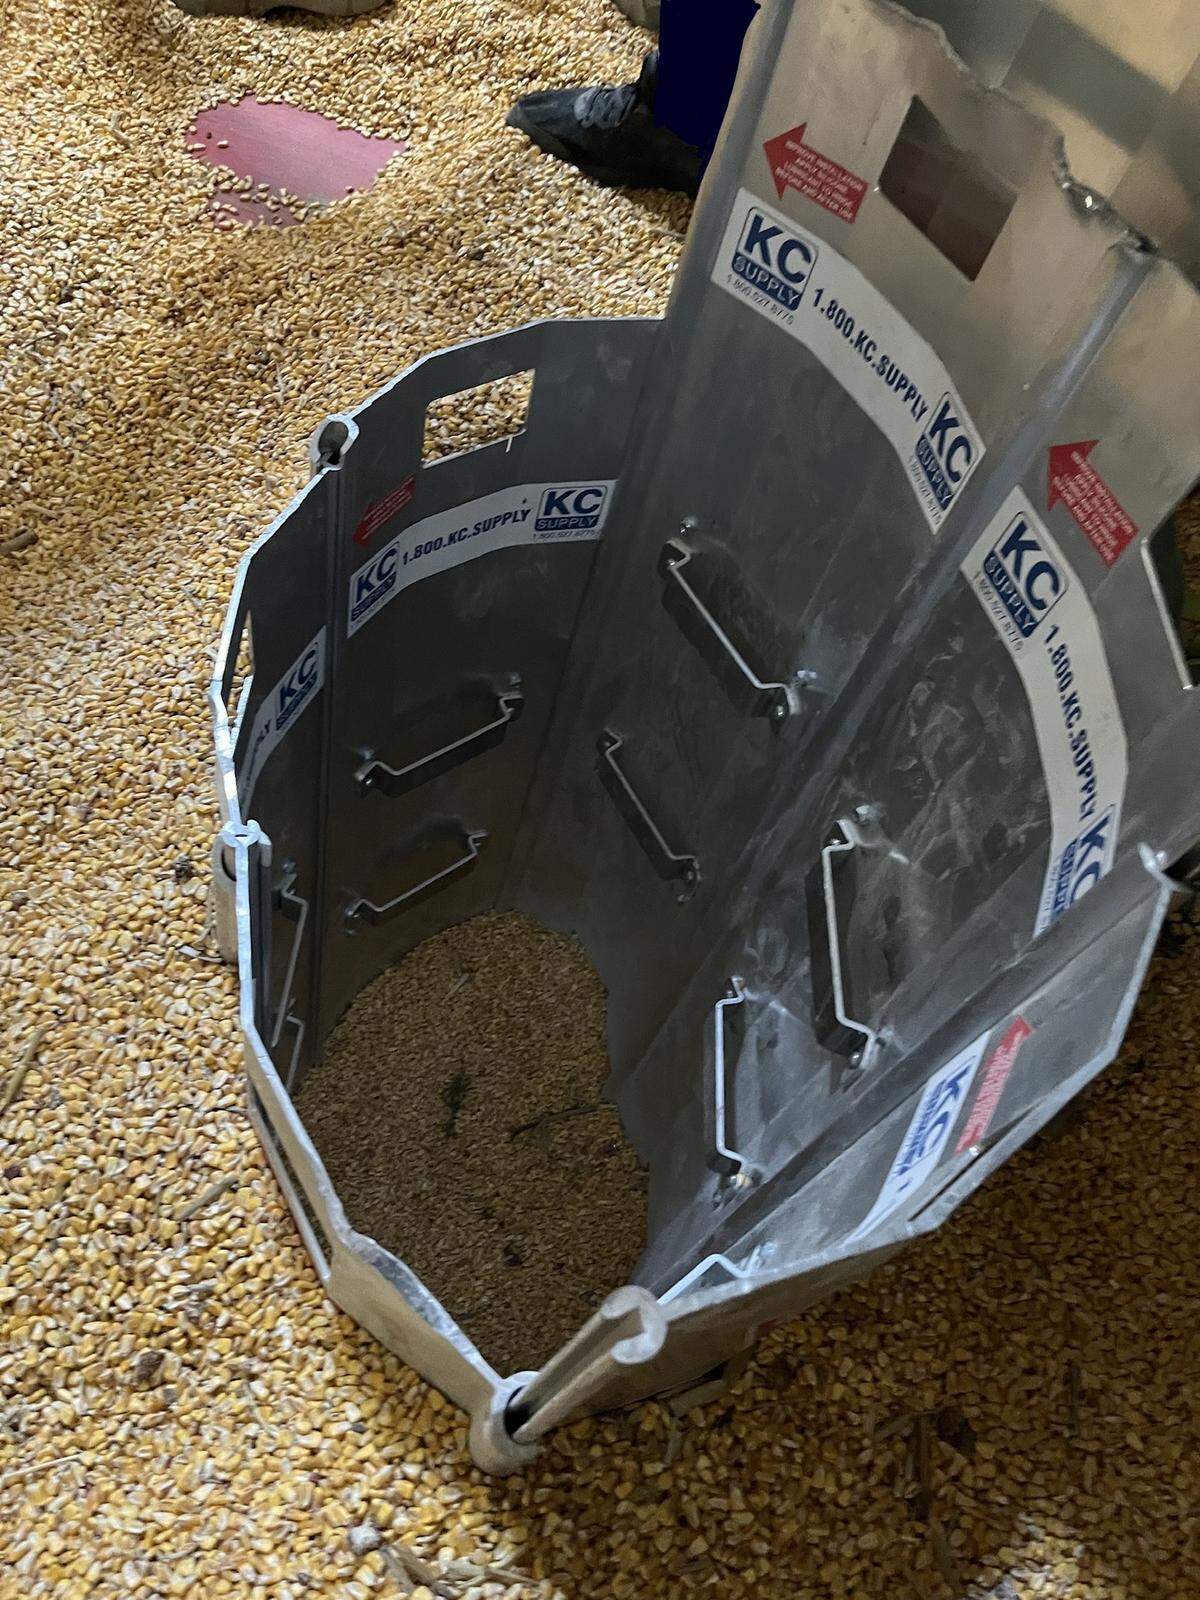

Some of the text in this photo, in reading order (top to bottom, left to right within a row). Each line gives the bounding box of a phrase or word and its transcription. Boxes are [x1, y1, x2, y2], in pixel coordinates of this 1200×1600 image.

[733, 256, 799, 306] SUPPLY
[744, 214, 812, 284] KC
[813, 288, 929, 422] 1.800.KC.SUPPLY
[929, 400, 972, 483] KC
[536, 516, 596, 531] SUPPLY
[544, 488, 603, 517] KC
[403, 509, 531, 566] 1.800.KC.SUPPLY
[1001, 520, 1060, 611] KC
[356, 547, 398, 604] KC
[985, 556, 1038, 631] SUPPLY
[279, 649, 317, 714] KC
[1045, 625, 1097, 821] 1.800.KC.SUPPLY
